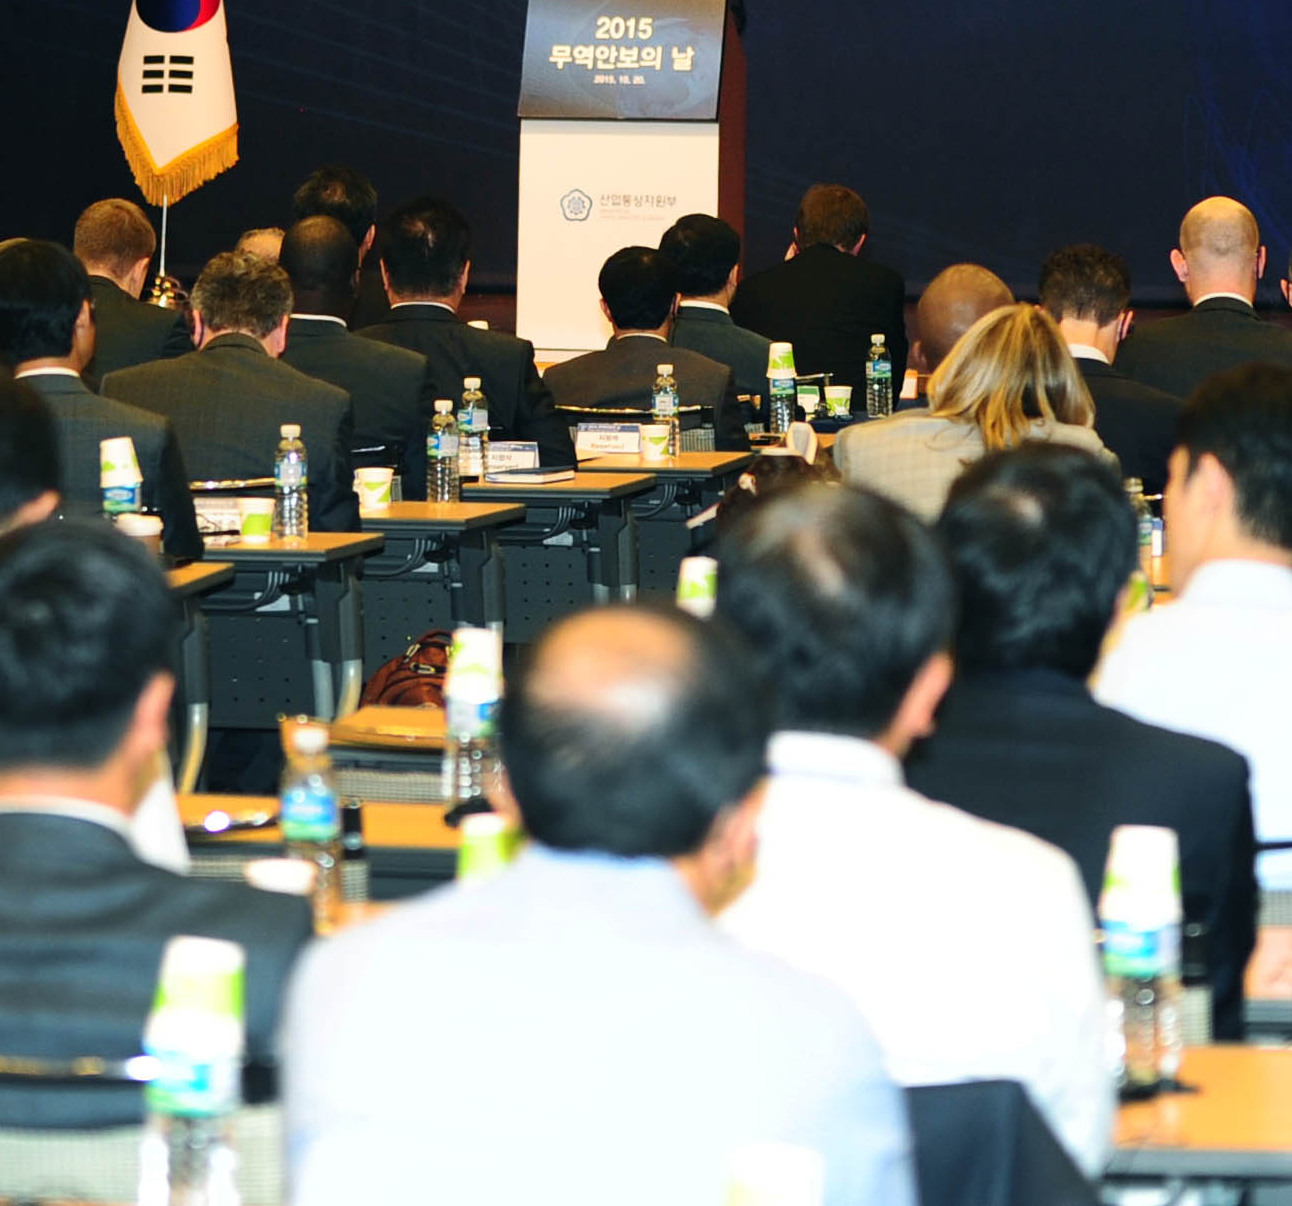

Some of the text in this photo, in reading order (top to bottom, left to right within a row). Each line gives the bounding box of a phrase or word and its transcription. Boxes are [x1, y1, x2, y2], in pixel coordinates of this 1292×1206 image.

[594, 15, 654, 41] 2015
[548, 44, 696, 71] 무역안보의 날
